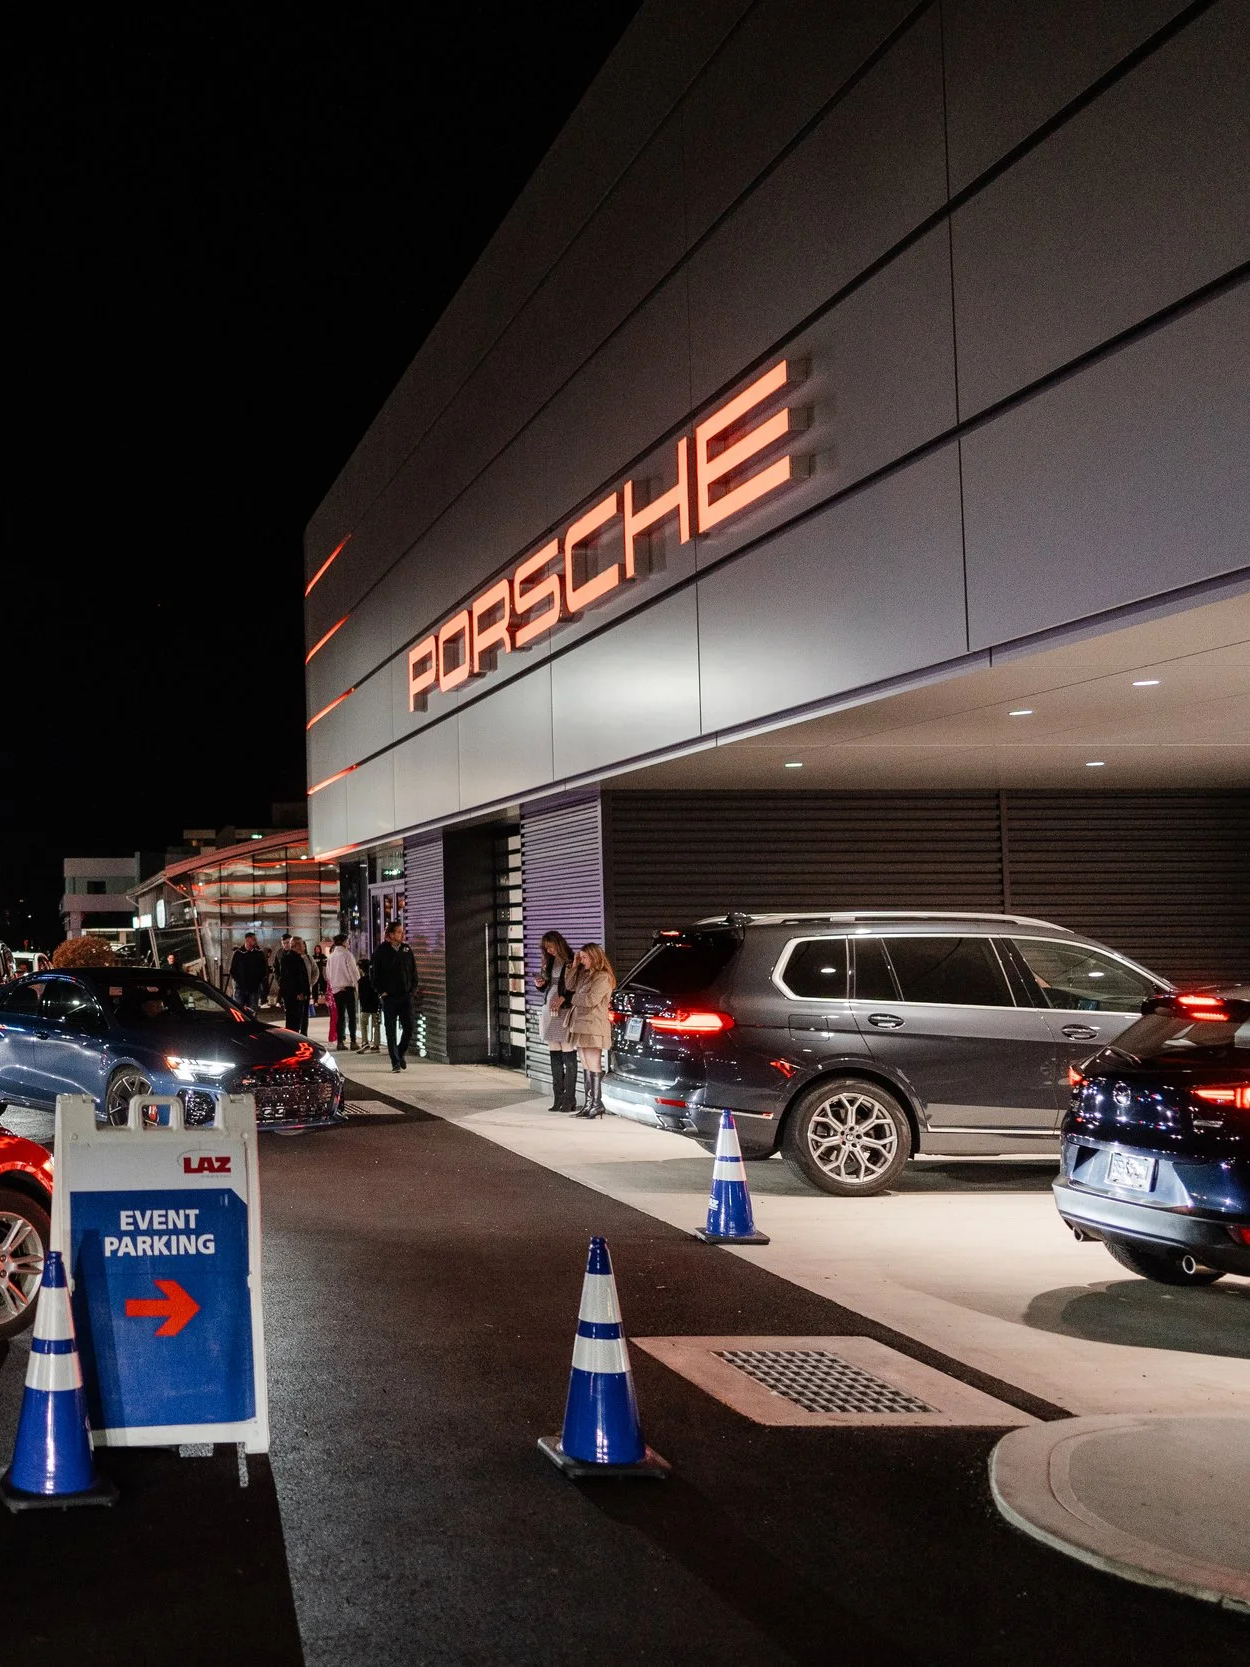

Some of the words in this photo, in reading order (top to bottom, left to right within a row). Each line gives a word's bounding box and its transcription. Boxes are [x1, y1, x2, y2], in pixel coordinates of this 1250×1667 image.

[408, 359, 791, 713] PORSCHE
[183, 1156, 232, 1174] LAZ
[120, 1209, 199, 1230] EVENT
[104, 1234, 215, 1257] PARKING
